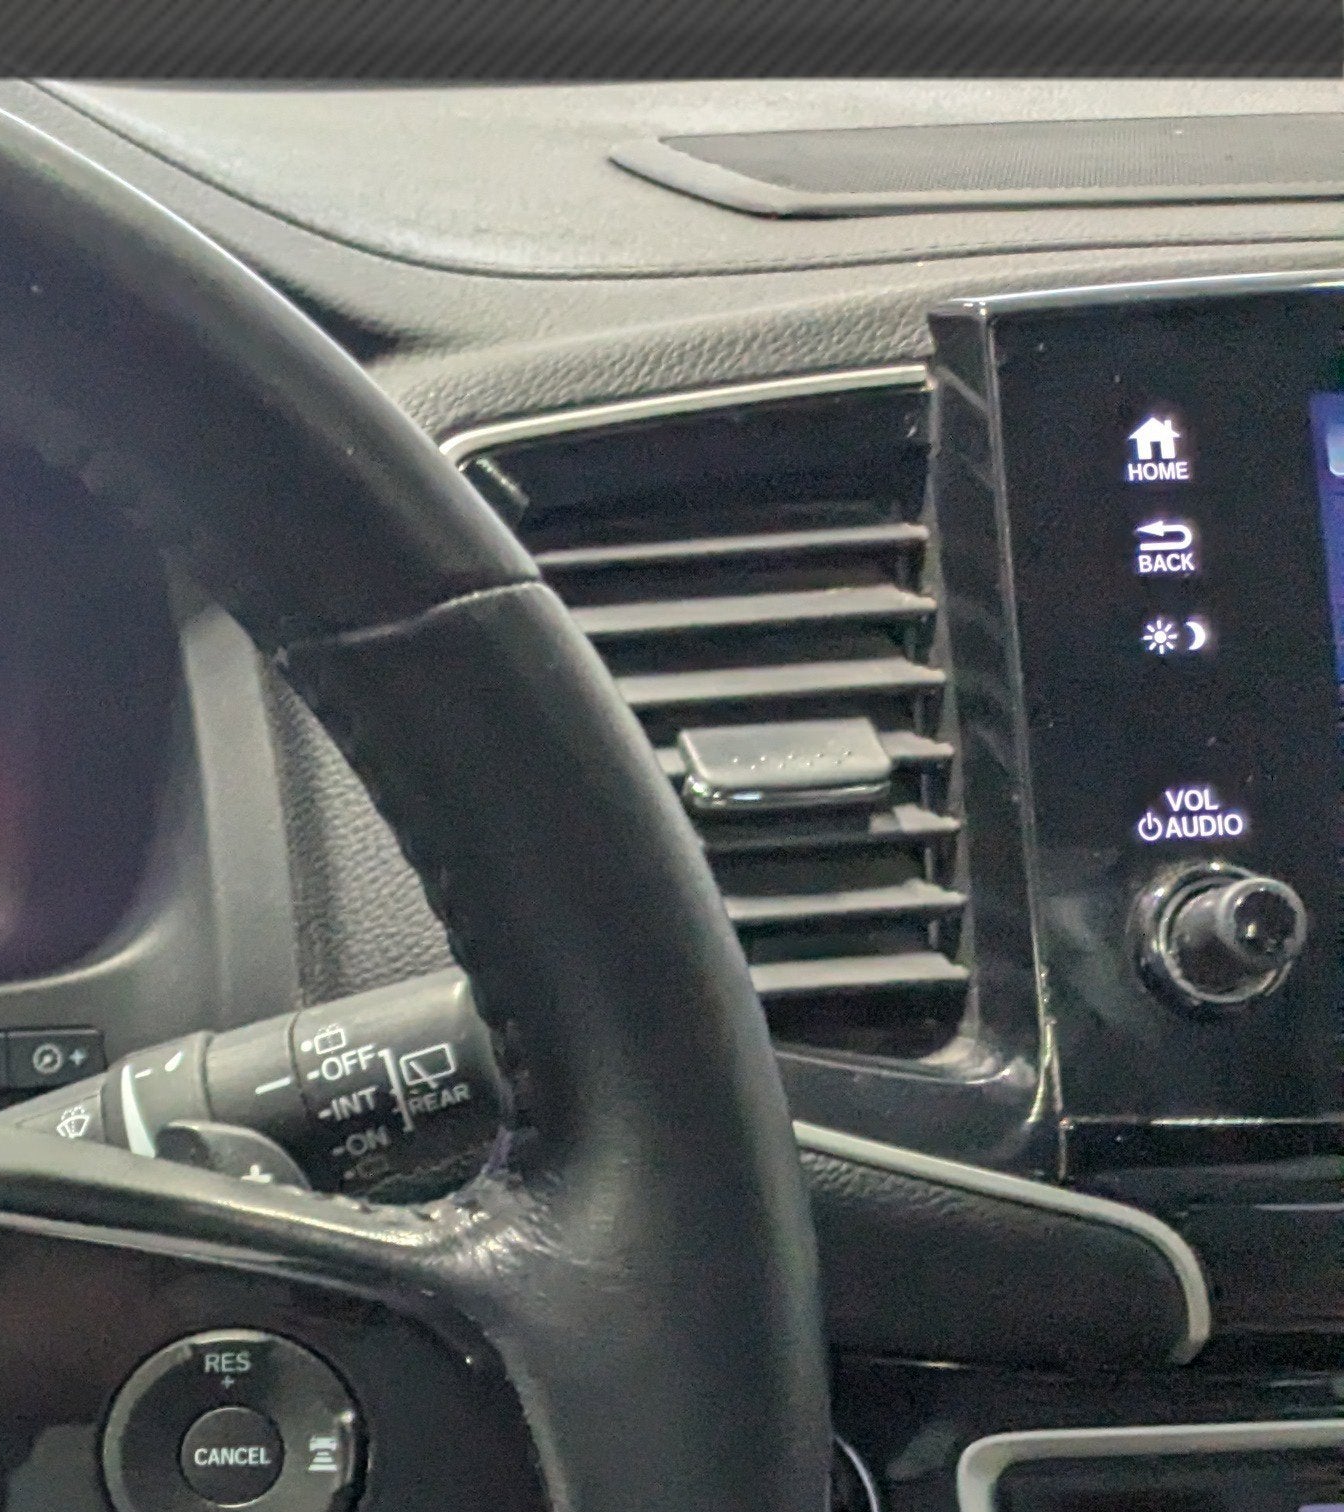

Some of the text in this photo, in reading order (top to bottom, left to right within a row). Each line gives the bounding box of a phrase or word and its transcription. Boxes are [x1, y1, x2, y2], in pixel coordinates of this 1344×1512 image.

[1128, 461, 1190, 482] HOME
[1138, 553, 1195, 574] BACK
[1165, 788, 1220, 812] VOL
[1165, 813, 1244, 838] AUDIO
[320, 1043, 377, 1081] OFF
[330, 1086, 378, 1121] INT
[204, 1350, 252, 1373] RES
[193, 1445, 272, 1467] CANCEL
